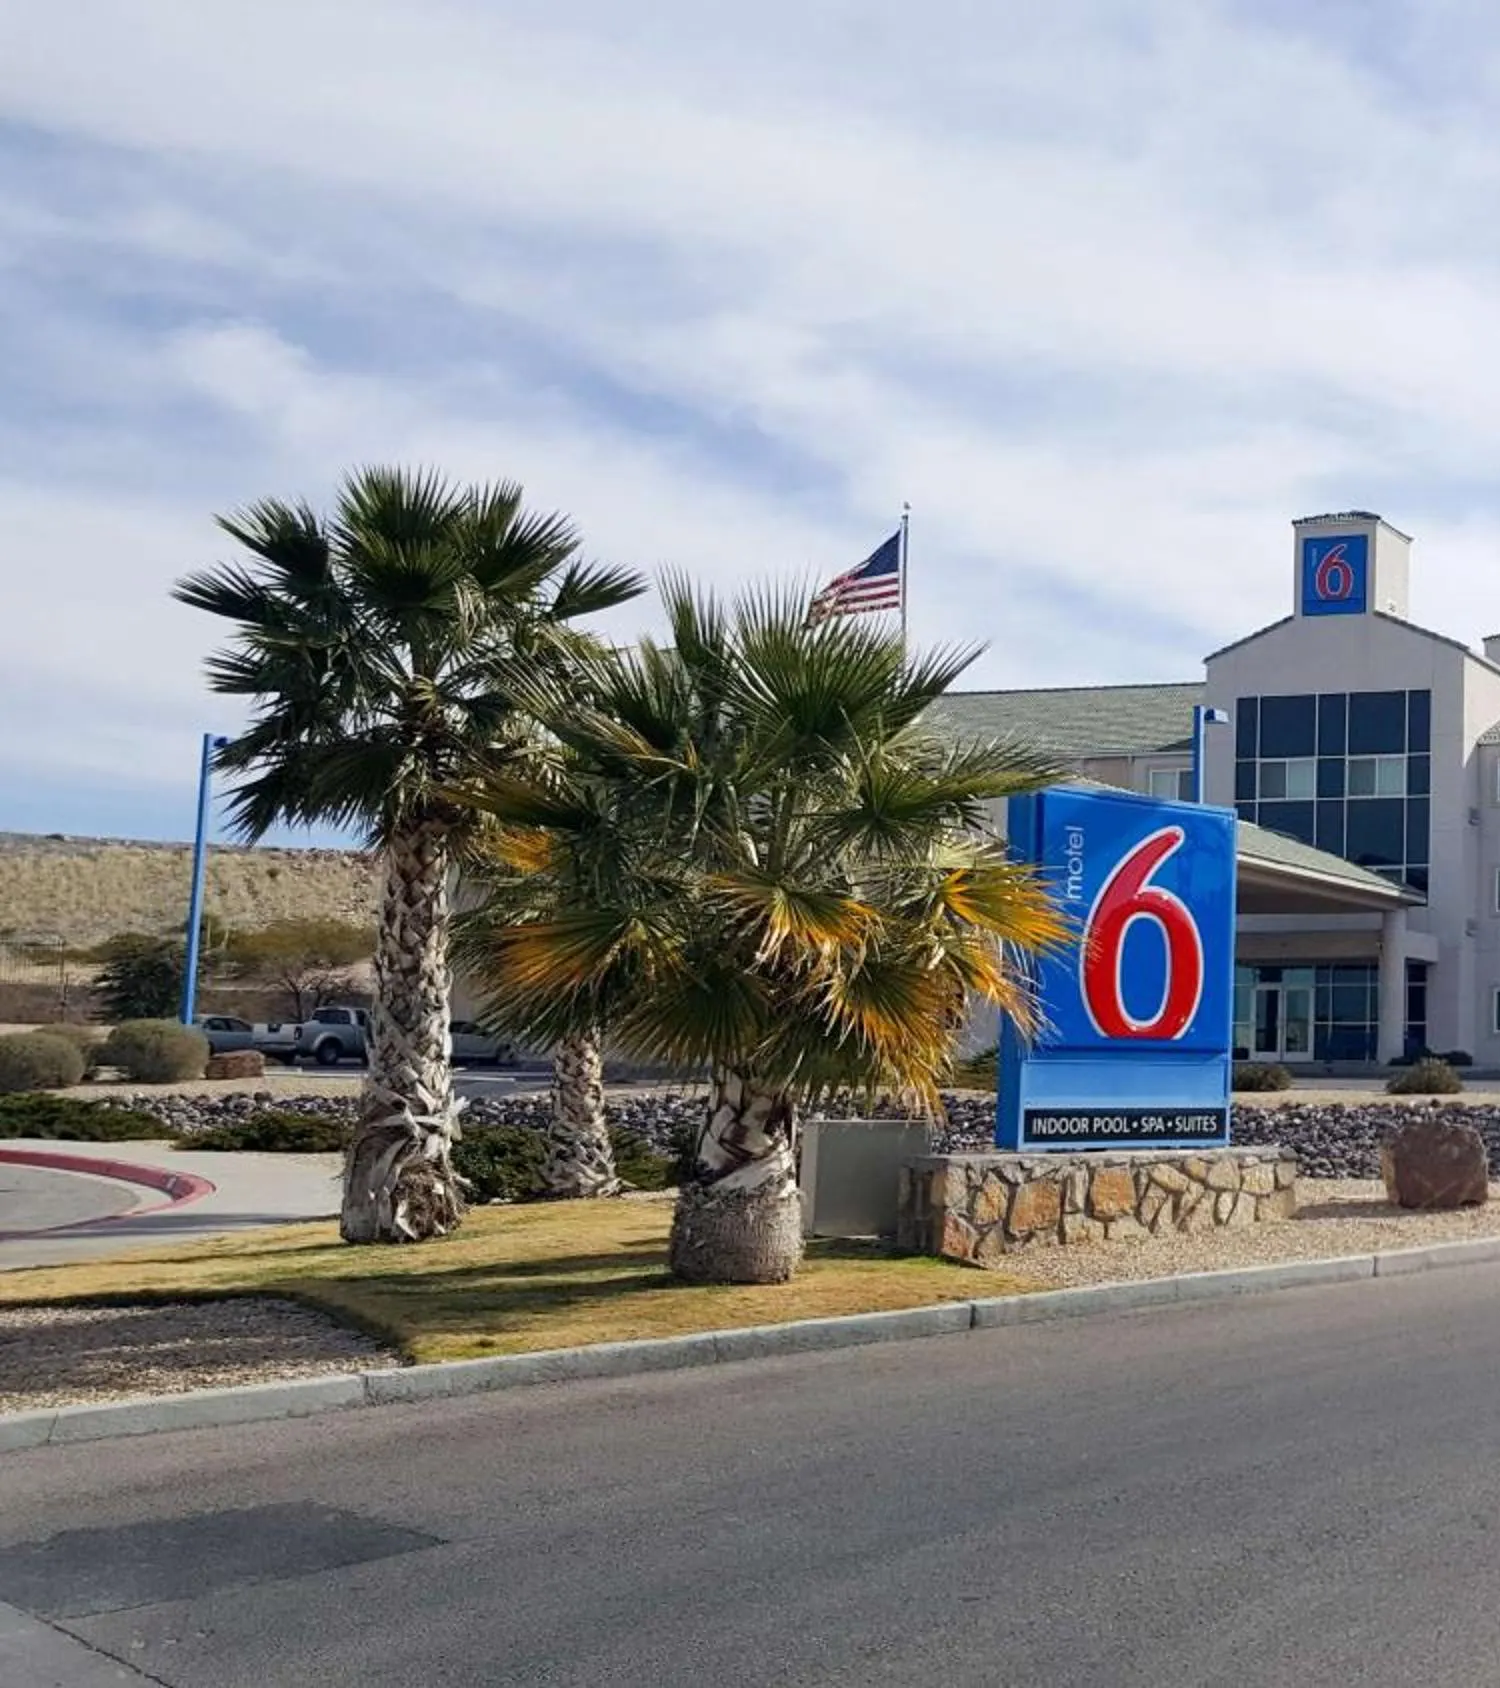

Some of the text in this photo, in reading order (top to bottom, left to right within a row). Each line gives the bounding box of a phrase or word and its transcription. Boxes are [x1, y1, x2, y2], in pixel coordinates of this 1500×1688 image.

[1315, 543, 1353, 600] 6
[1064, 825, 1084, 899] motel
[1079, 825, 1204, 1040] 6
[1032, 1115, 1217, 1135] INDOOR POOL SPA SUITES
